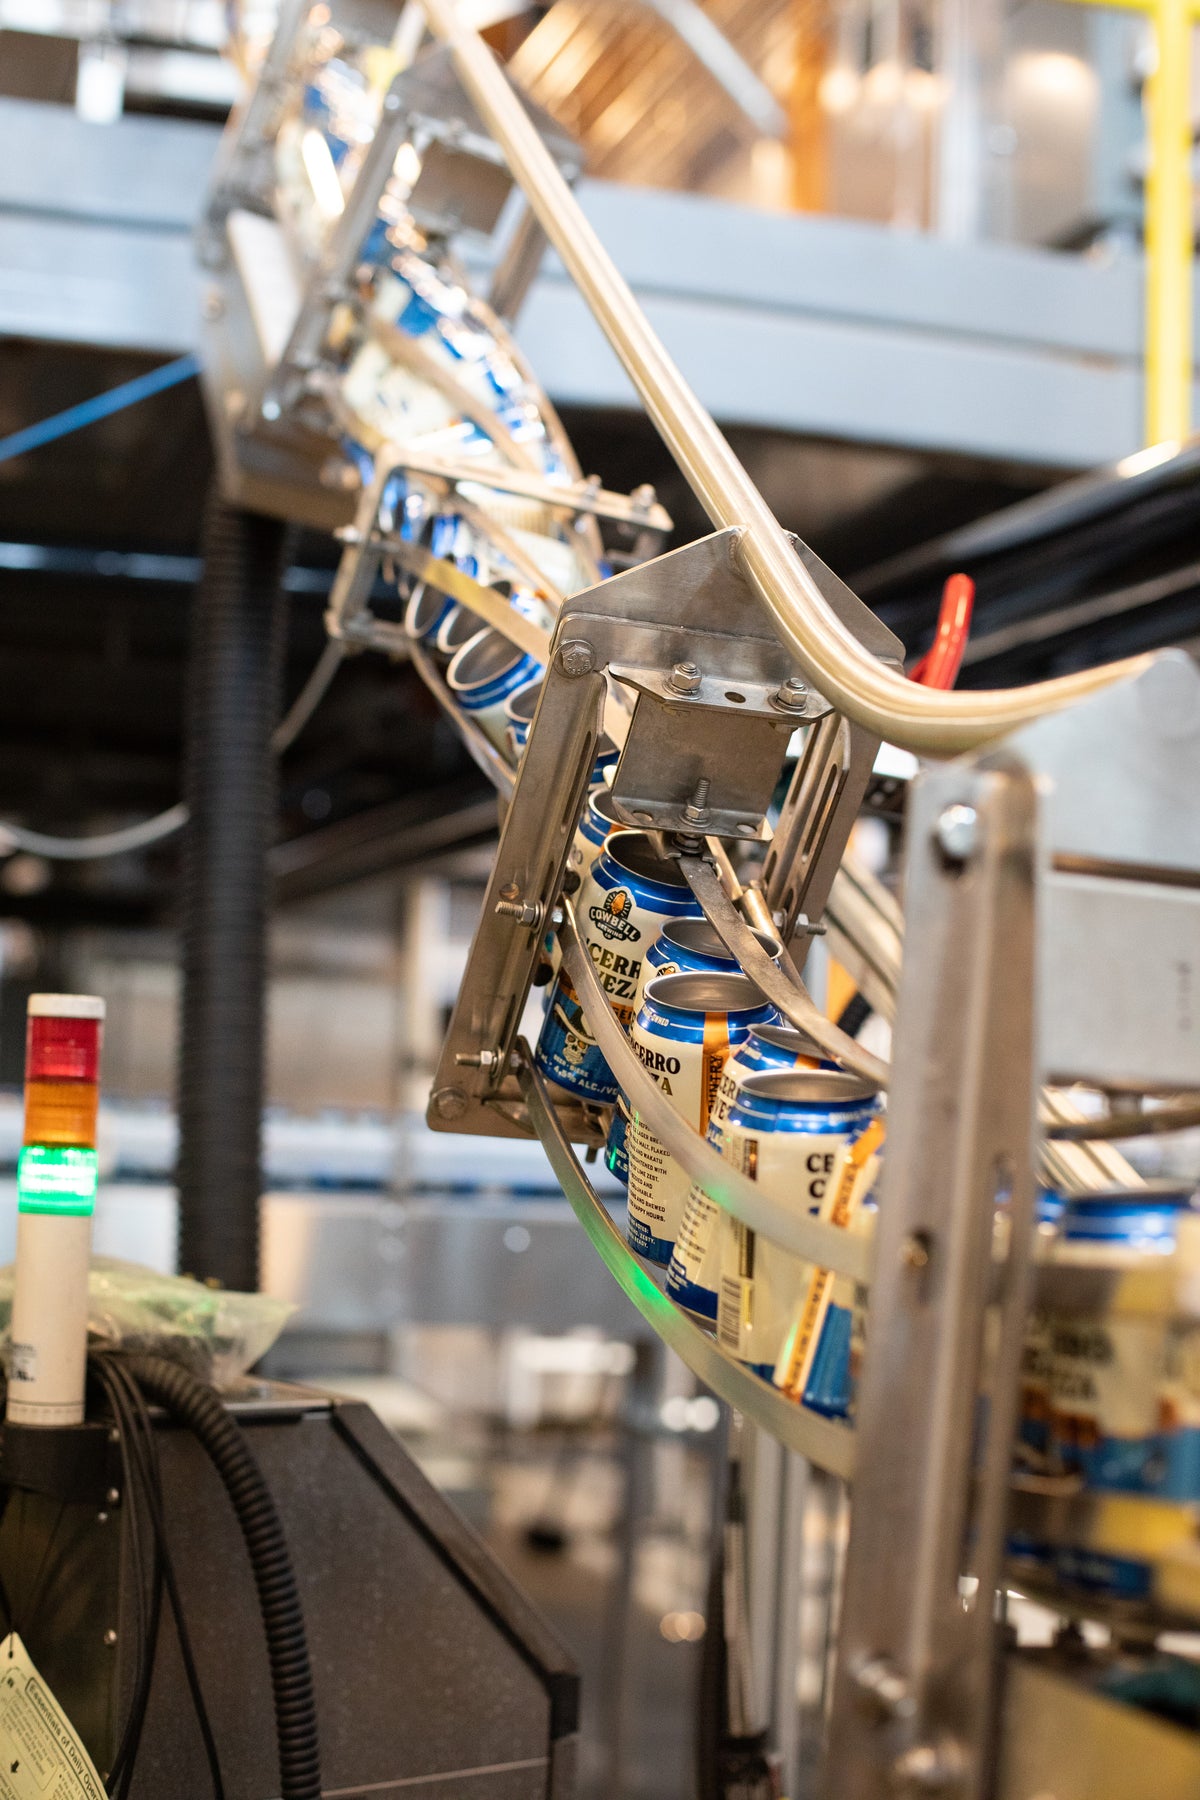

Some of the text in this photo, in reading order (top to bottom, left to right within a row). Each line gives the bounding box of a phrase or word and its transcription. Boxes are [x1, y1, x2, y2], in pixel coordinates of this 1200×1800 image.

[590, 908, 638, 940] COWBELL
[597, 922, 624, 940] BREWING
[654, 1167, 667, 1175] WITH
[645, 1201, 666, 1213] BREWED
[29, 1684, 99, 1800] Essentials of Daily Oper
